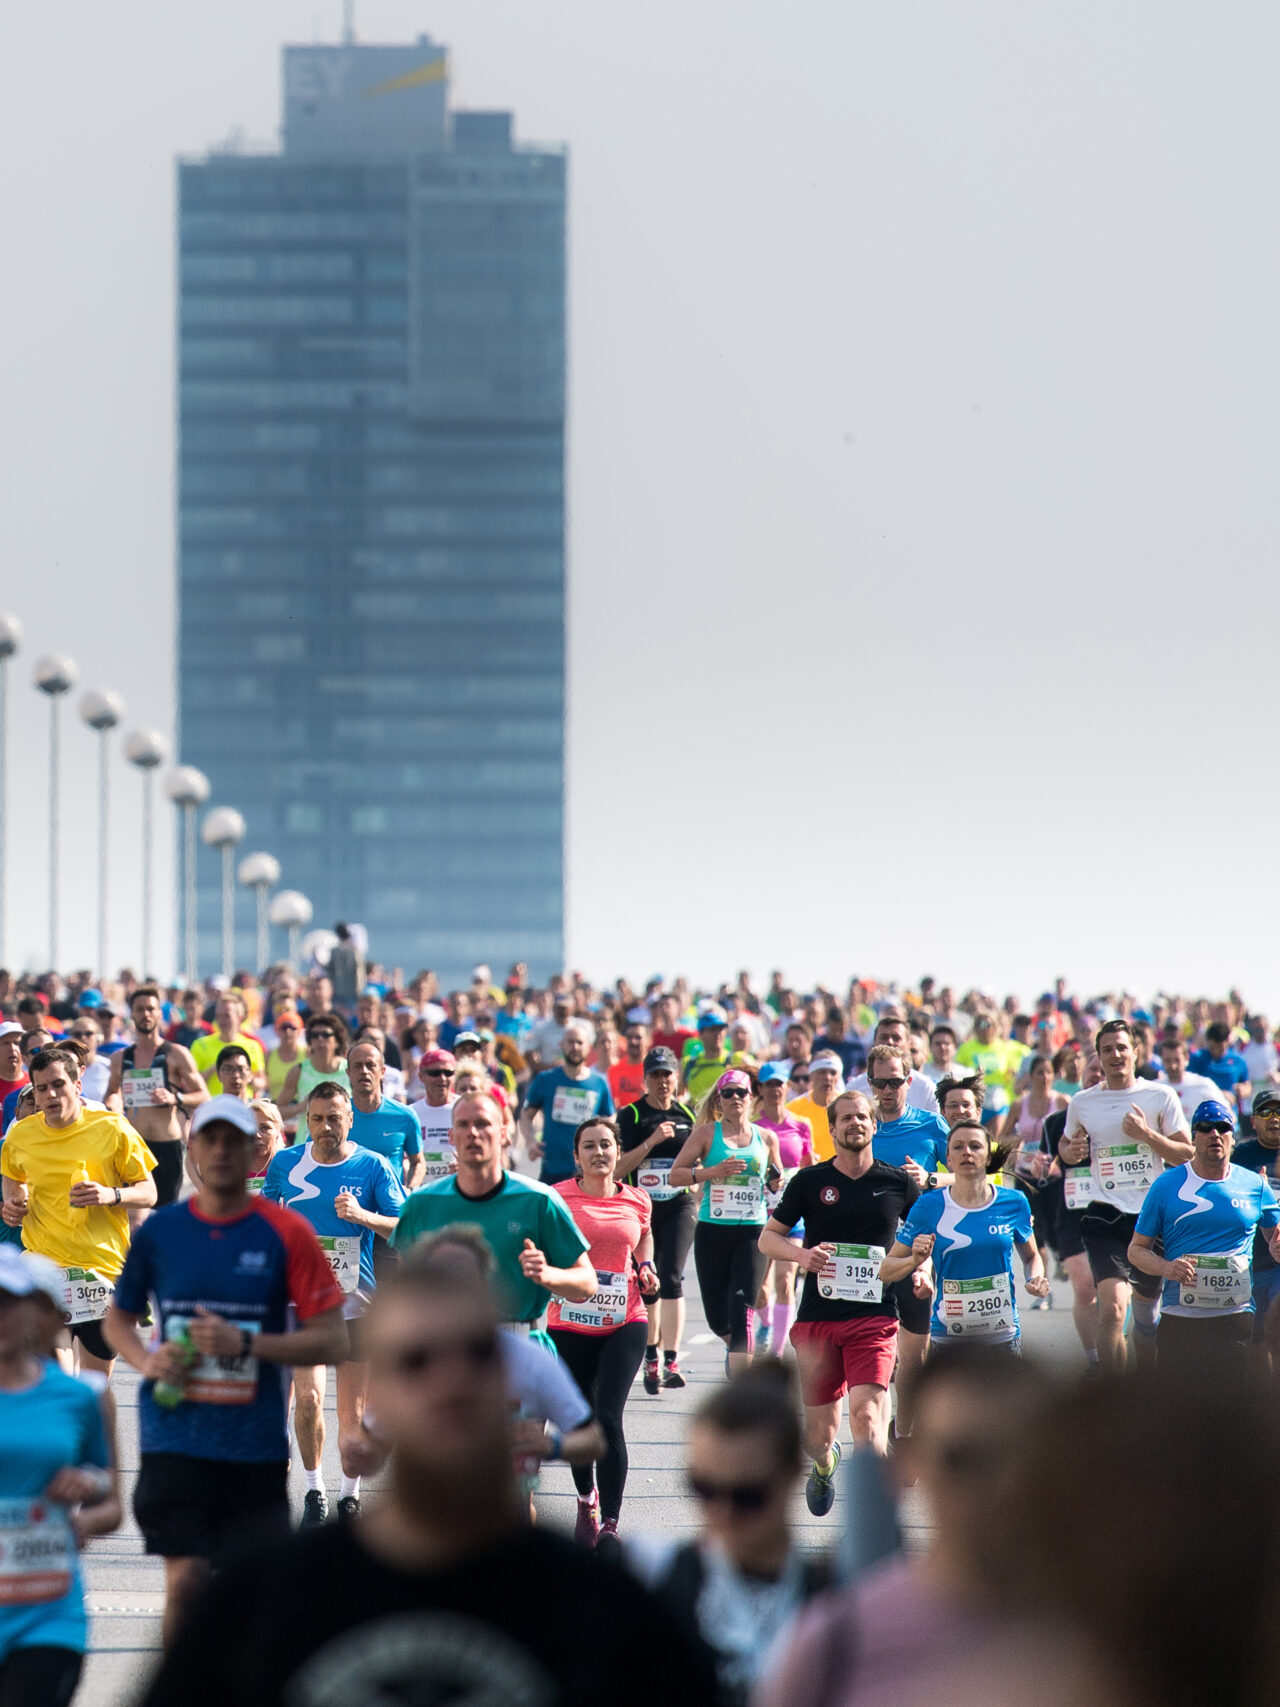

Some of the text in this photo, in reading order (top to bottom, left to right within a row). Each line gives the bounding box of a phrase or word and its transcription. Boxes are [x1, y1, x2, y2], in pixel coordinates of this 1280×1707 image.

[291, 57, 352, 100] EY
[1118, 1160, 1145, 1172] 1065
[728, 1191, 754, 1201] 1406
[1231, 1198, 1252, 1210] ors
[988, 1223, 1012, 1235] ors
[341, 1262, 349, 1270] A
[845, 1266, 874, 1279] 3194
[1202, 1275, 1233, 1287] 1682
[76, 1286, 106, 1299] 3079
[589, 1293, 626, 1306] 20270
[967, 1296, 1010, 1313] 2360 A
[568, 1311, 601, 1326] ERSTE
[980, 1309, 1001, 1317] Martina
